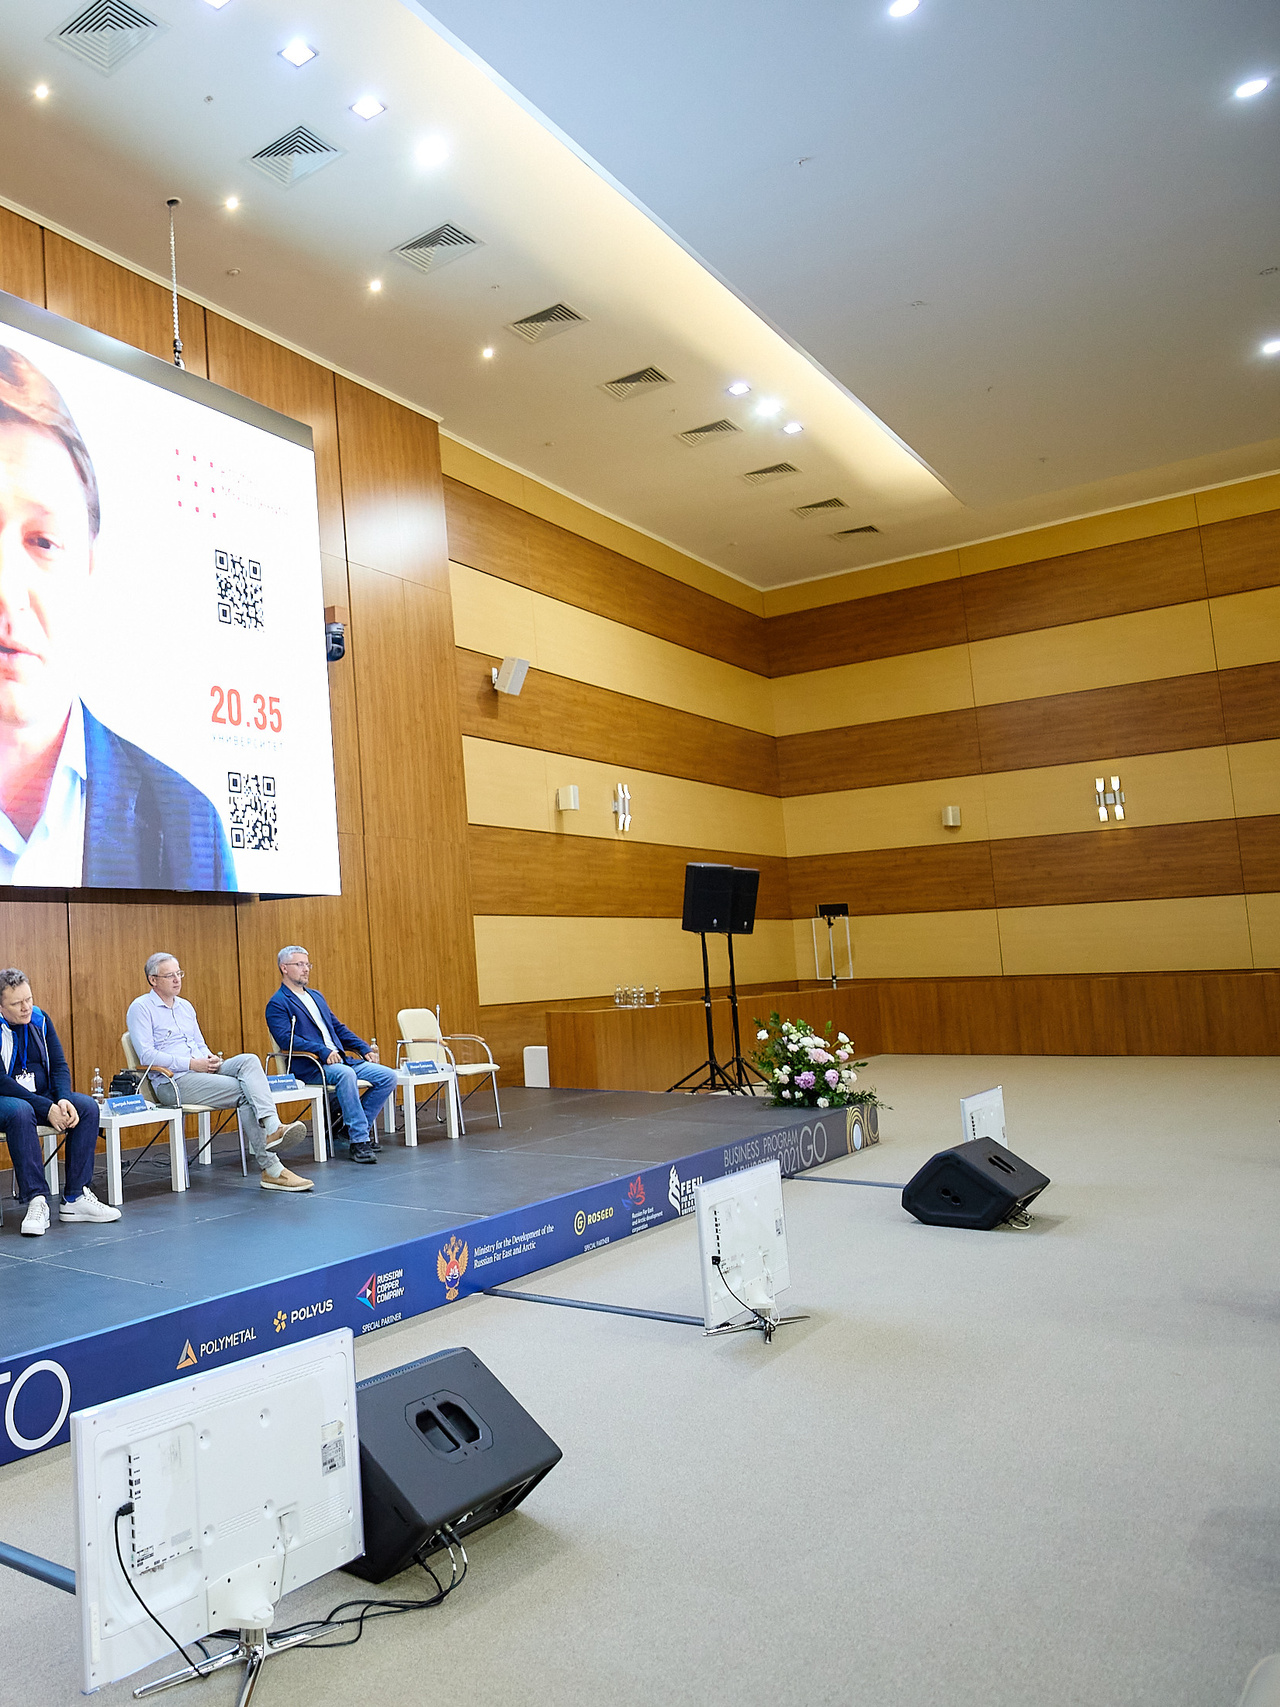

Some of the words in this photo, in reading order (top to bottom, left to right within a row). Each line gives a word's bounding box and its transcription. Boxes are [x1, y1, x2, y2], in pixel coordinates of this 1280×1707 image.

[210, 685, 282, 733] 20.35
[723, 1140, 760, 1168] BUSINESS
[763, 1128, 798, 1154] PROGRAM
[800, 1122, 827, 1168] GO
[587, 1206, 614, 1226] ROSGEO
[474, 1243, 495, 1258] Ministry
[495, 1240, 503, 1250] for
[503, 1237, 512, 1248] the
[512, 1229, 541, 1245] Development
[541, 1225, 547, 1235] of
[547, 1223, 555, 1233] the
[473, 1255, 494, 1269] Russian
[493, 1251, 502, 1263] Far
[502, 1248, 513, 1260] East
[512, 1244, 522, 1256] and
[522, 1240, 537, 1253] Arctic
[376, 1268, 404, 1285] RUSSIAN
[376, 1279, 400, 1295] COPPER
[376, 1286, 405, 1304] COMPANY
[290, 1298, 334, 1324] POLYUS
[361, 1319, 381, 1334] SPECIAL
[380, 1312, 402, 1327] PARTNER
[199, 1326, 257, 1358] POLYMETAL
